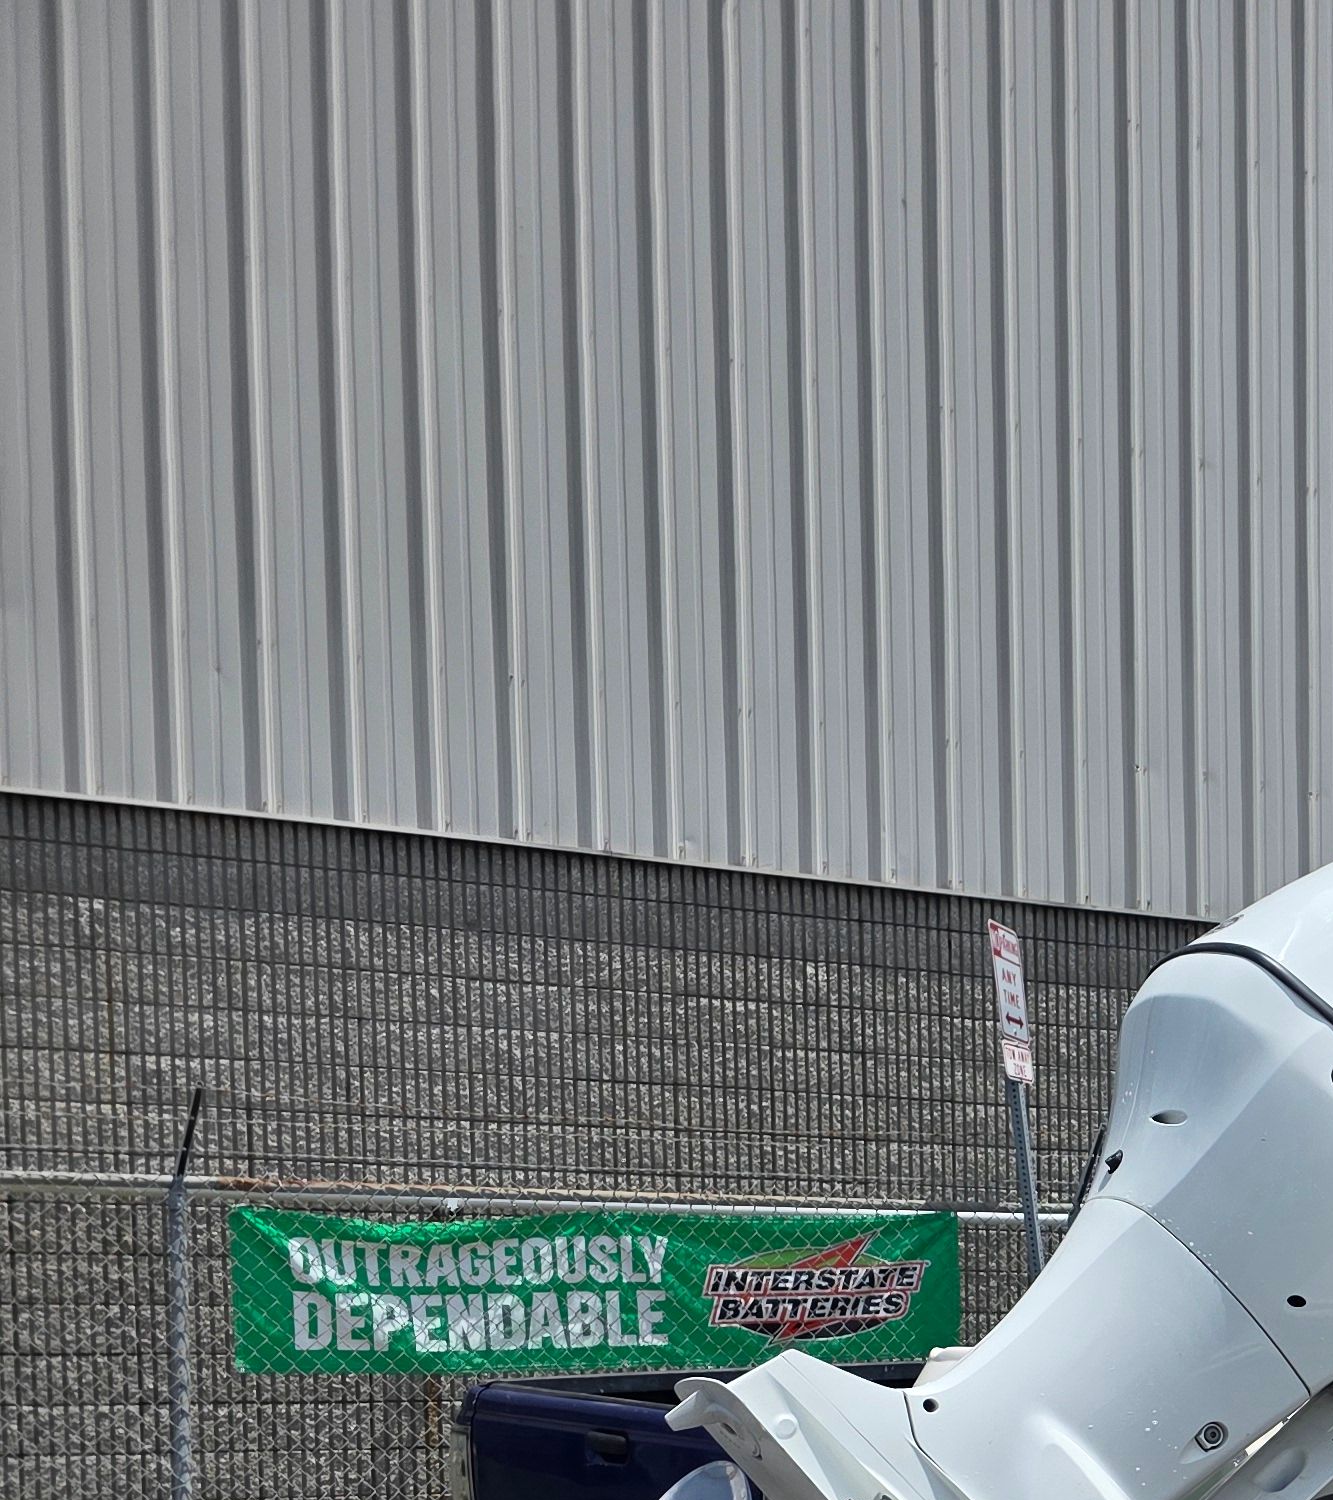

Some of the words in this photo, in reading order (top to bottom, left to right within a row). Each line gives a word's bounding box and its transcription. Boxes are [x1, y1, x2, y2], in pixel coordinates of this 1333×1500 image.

[1002, 968, 1016, 987] ANY
[1003, 989, 1021, 1009] TIME
[287, 1235, 669, 1287] OUTRAGEOUSLY
[710, 1265, 918, 1293] INTERSTATE
[717, 1293, 905, 1321] BATTERIES
[293, 1290, 669, 1353] DEPENDABLE
